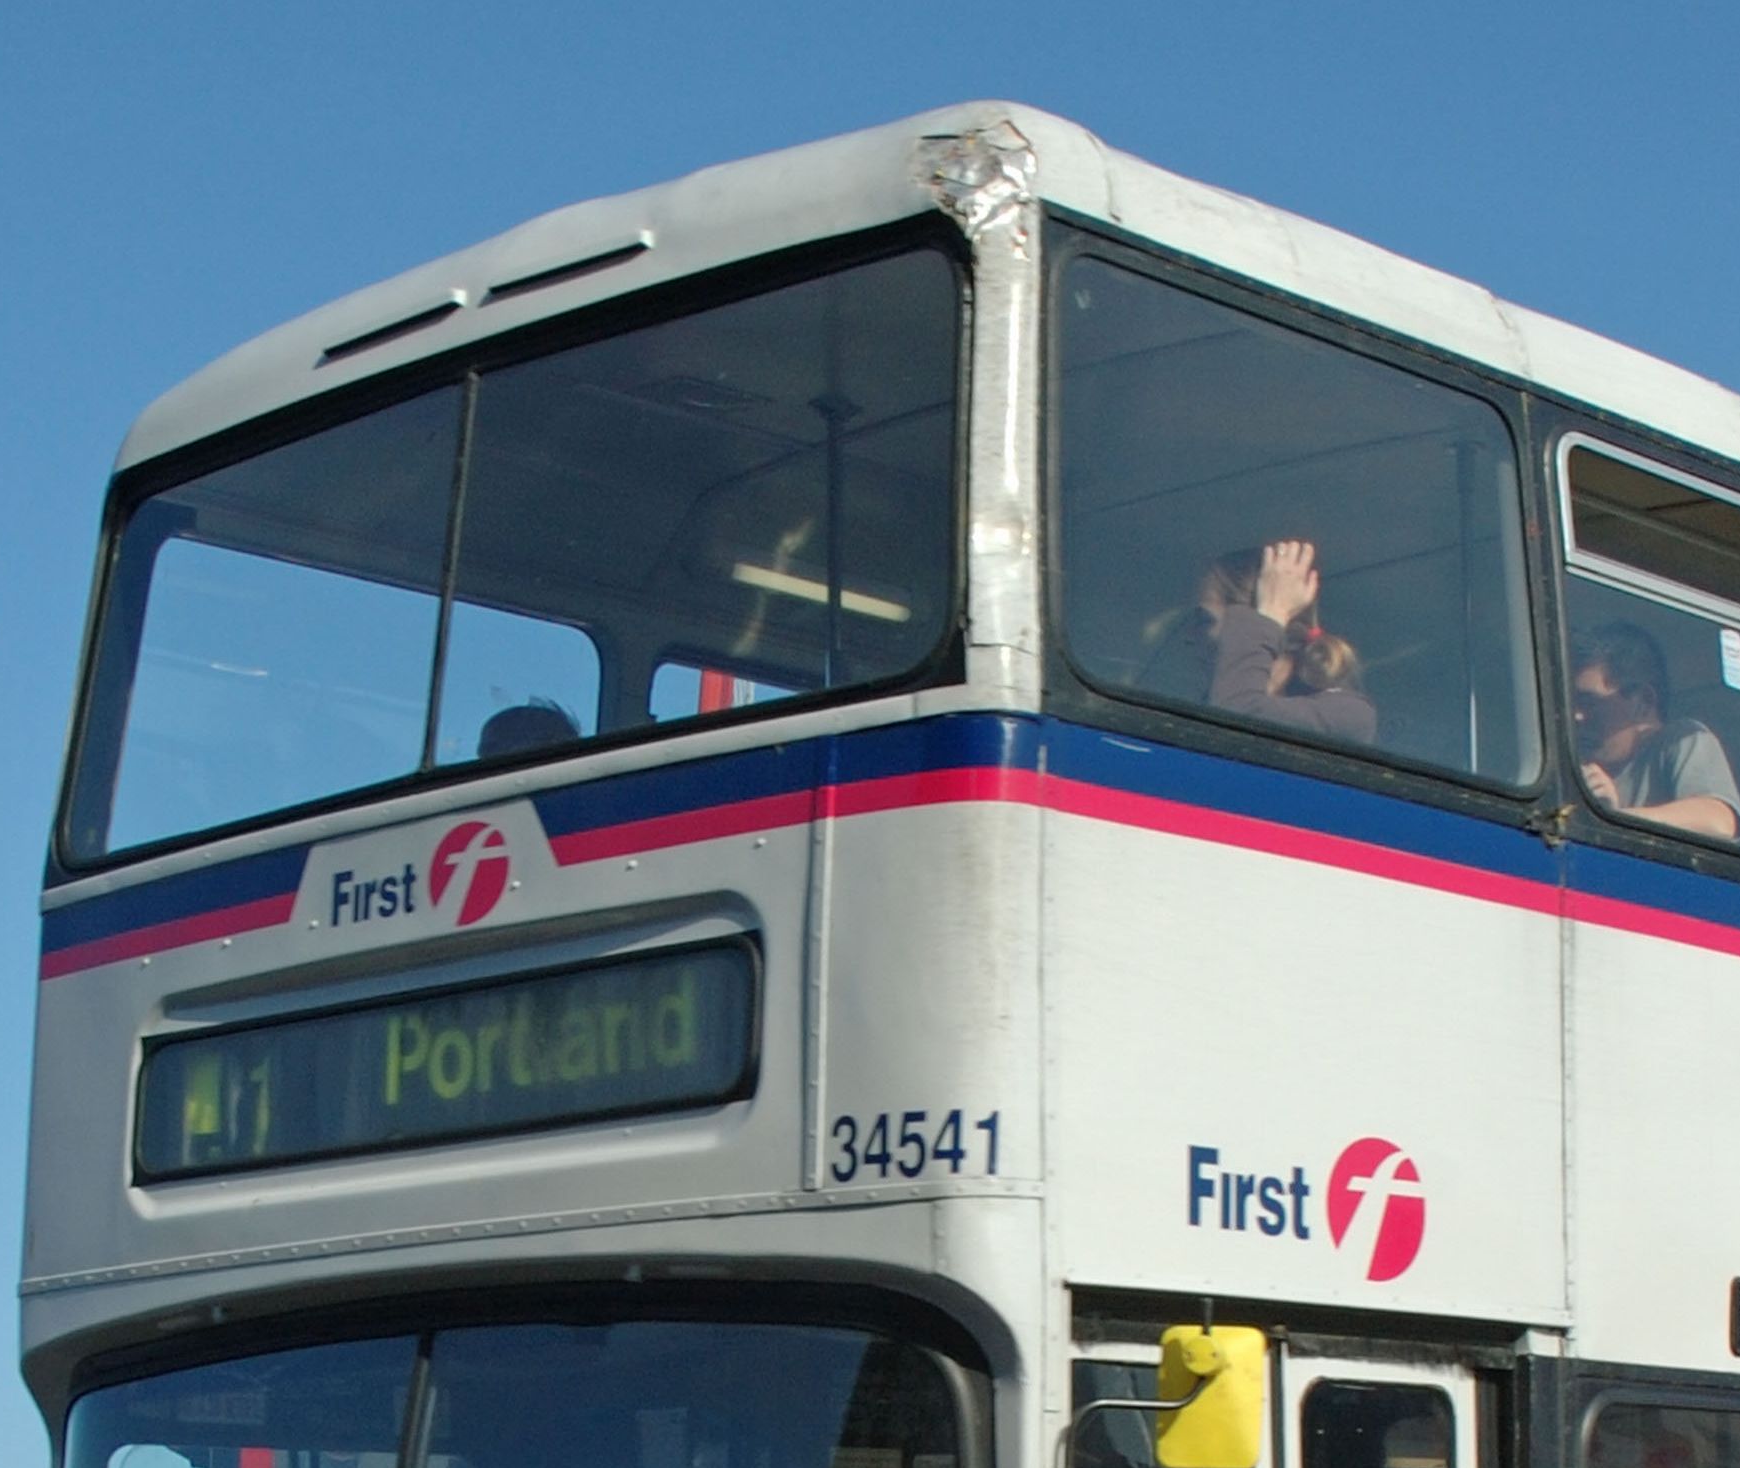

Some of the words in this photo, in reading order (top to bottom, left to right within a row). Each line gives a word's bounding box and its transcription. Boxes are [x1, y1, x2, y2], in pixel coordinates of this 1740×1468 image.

[332, 863, 417, 927] First
[385, 967, 697, 1106] Portland
[831, 1109, 999, 1183] 34541
[1188, 1144, 1310, 1241] First
